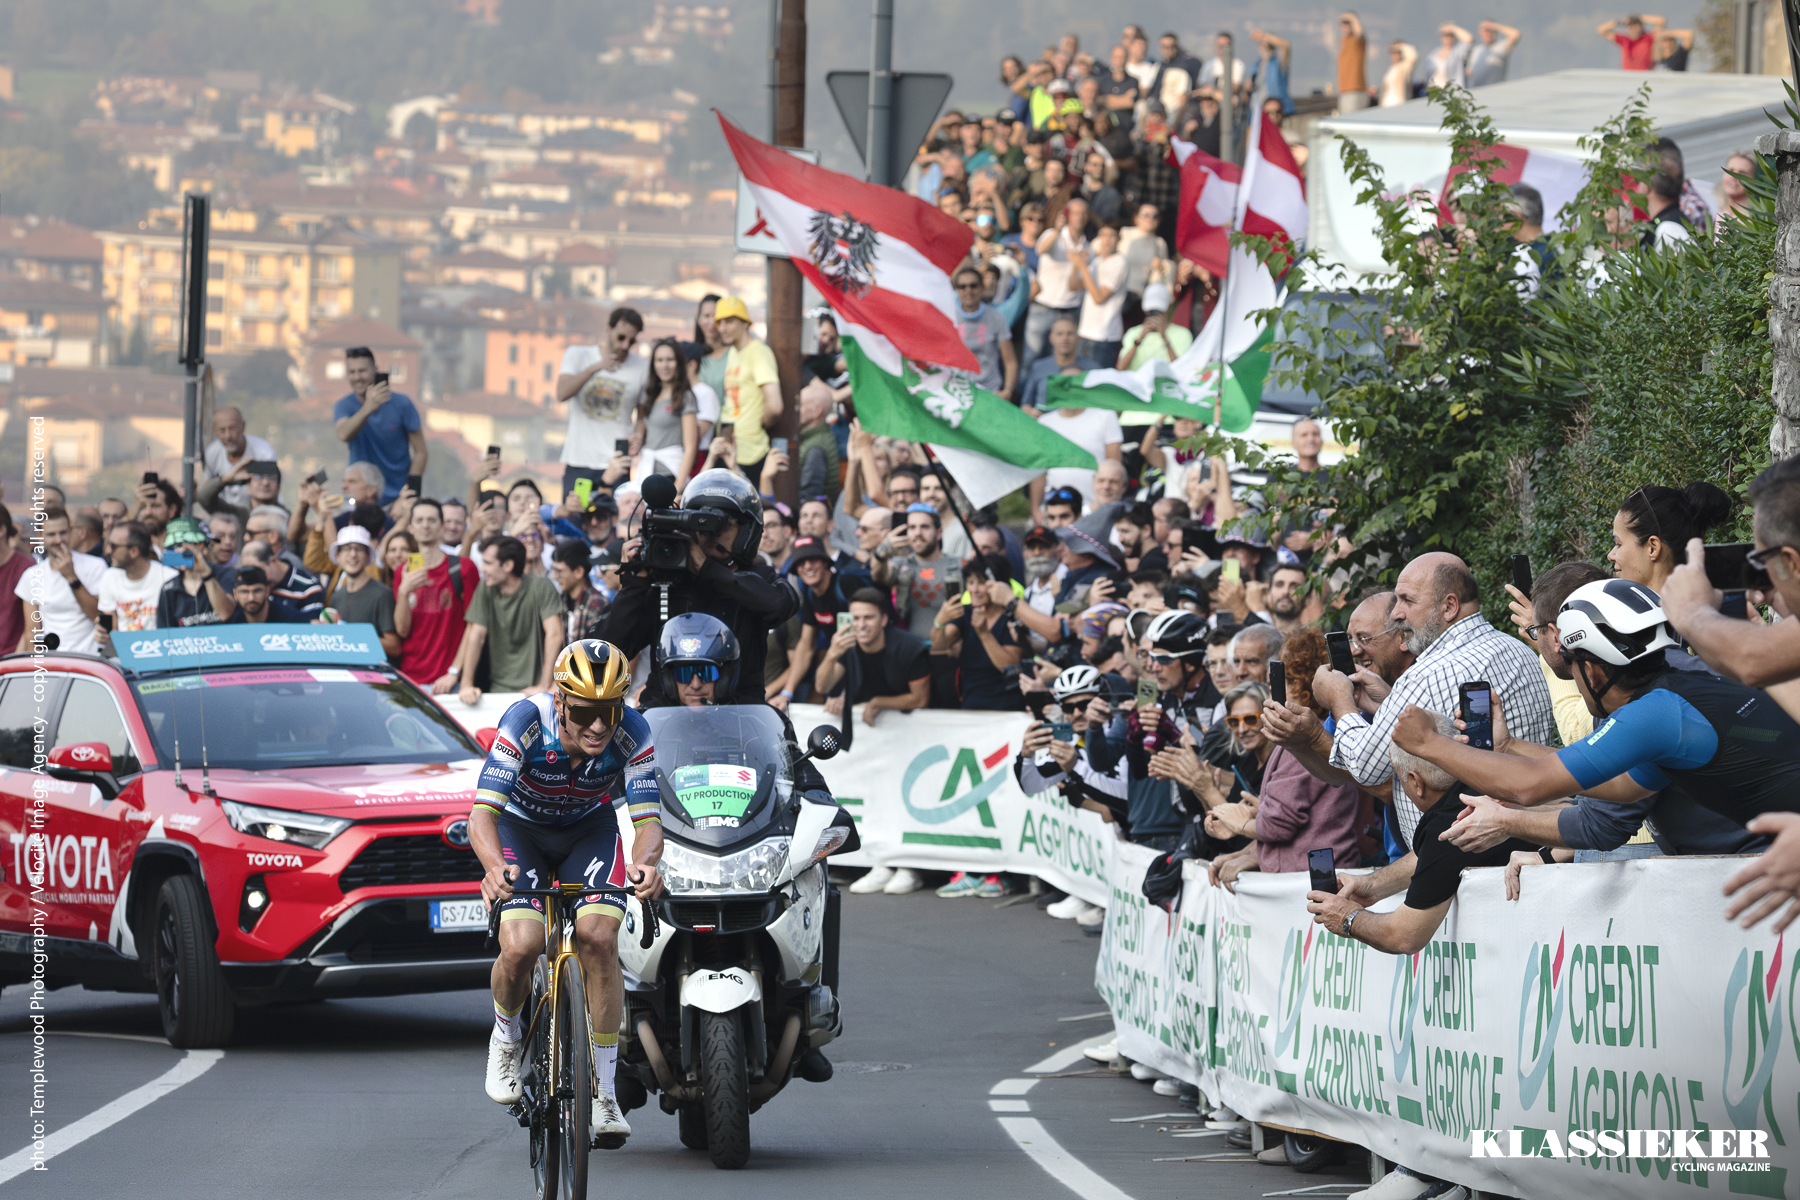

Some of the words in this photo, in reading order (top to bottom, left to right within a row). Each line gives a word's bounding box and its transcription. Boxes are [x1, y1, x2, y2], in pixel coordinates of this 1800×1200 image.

[1565, 632, 1583, 645] ABUS
[167, 642, 244, 656] AGRICOLE
[296, 642, 369, 653] AGRICOLE
[529, 767, 568, 782] Ekopak
[680, 792, 692, 802] TV
[693, 789, 754, 801] PRODUCTION
[712, 801, 723, 810] 17
[708, 816, 740, 828] EMG
[10, 833, 114, 891] TOYOTA
[246, 853, 303, 868] TOYOTA
[708, 973, 744, 985] EMG
[1423, 918, 1476, 1033] CRÉDIT
[1568, 918, 1659, 1049] CRÉDIT
[1304, 1023, 1392, 1116] AGRICOLE
[1426, 1045, 1504, 1143] AGRICOLE
[1566, 1065, 1710, 1189] AGRICOLE
